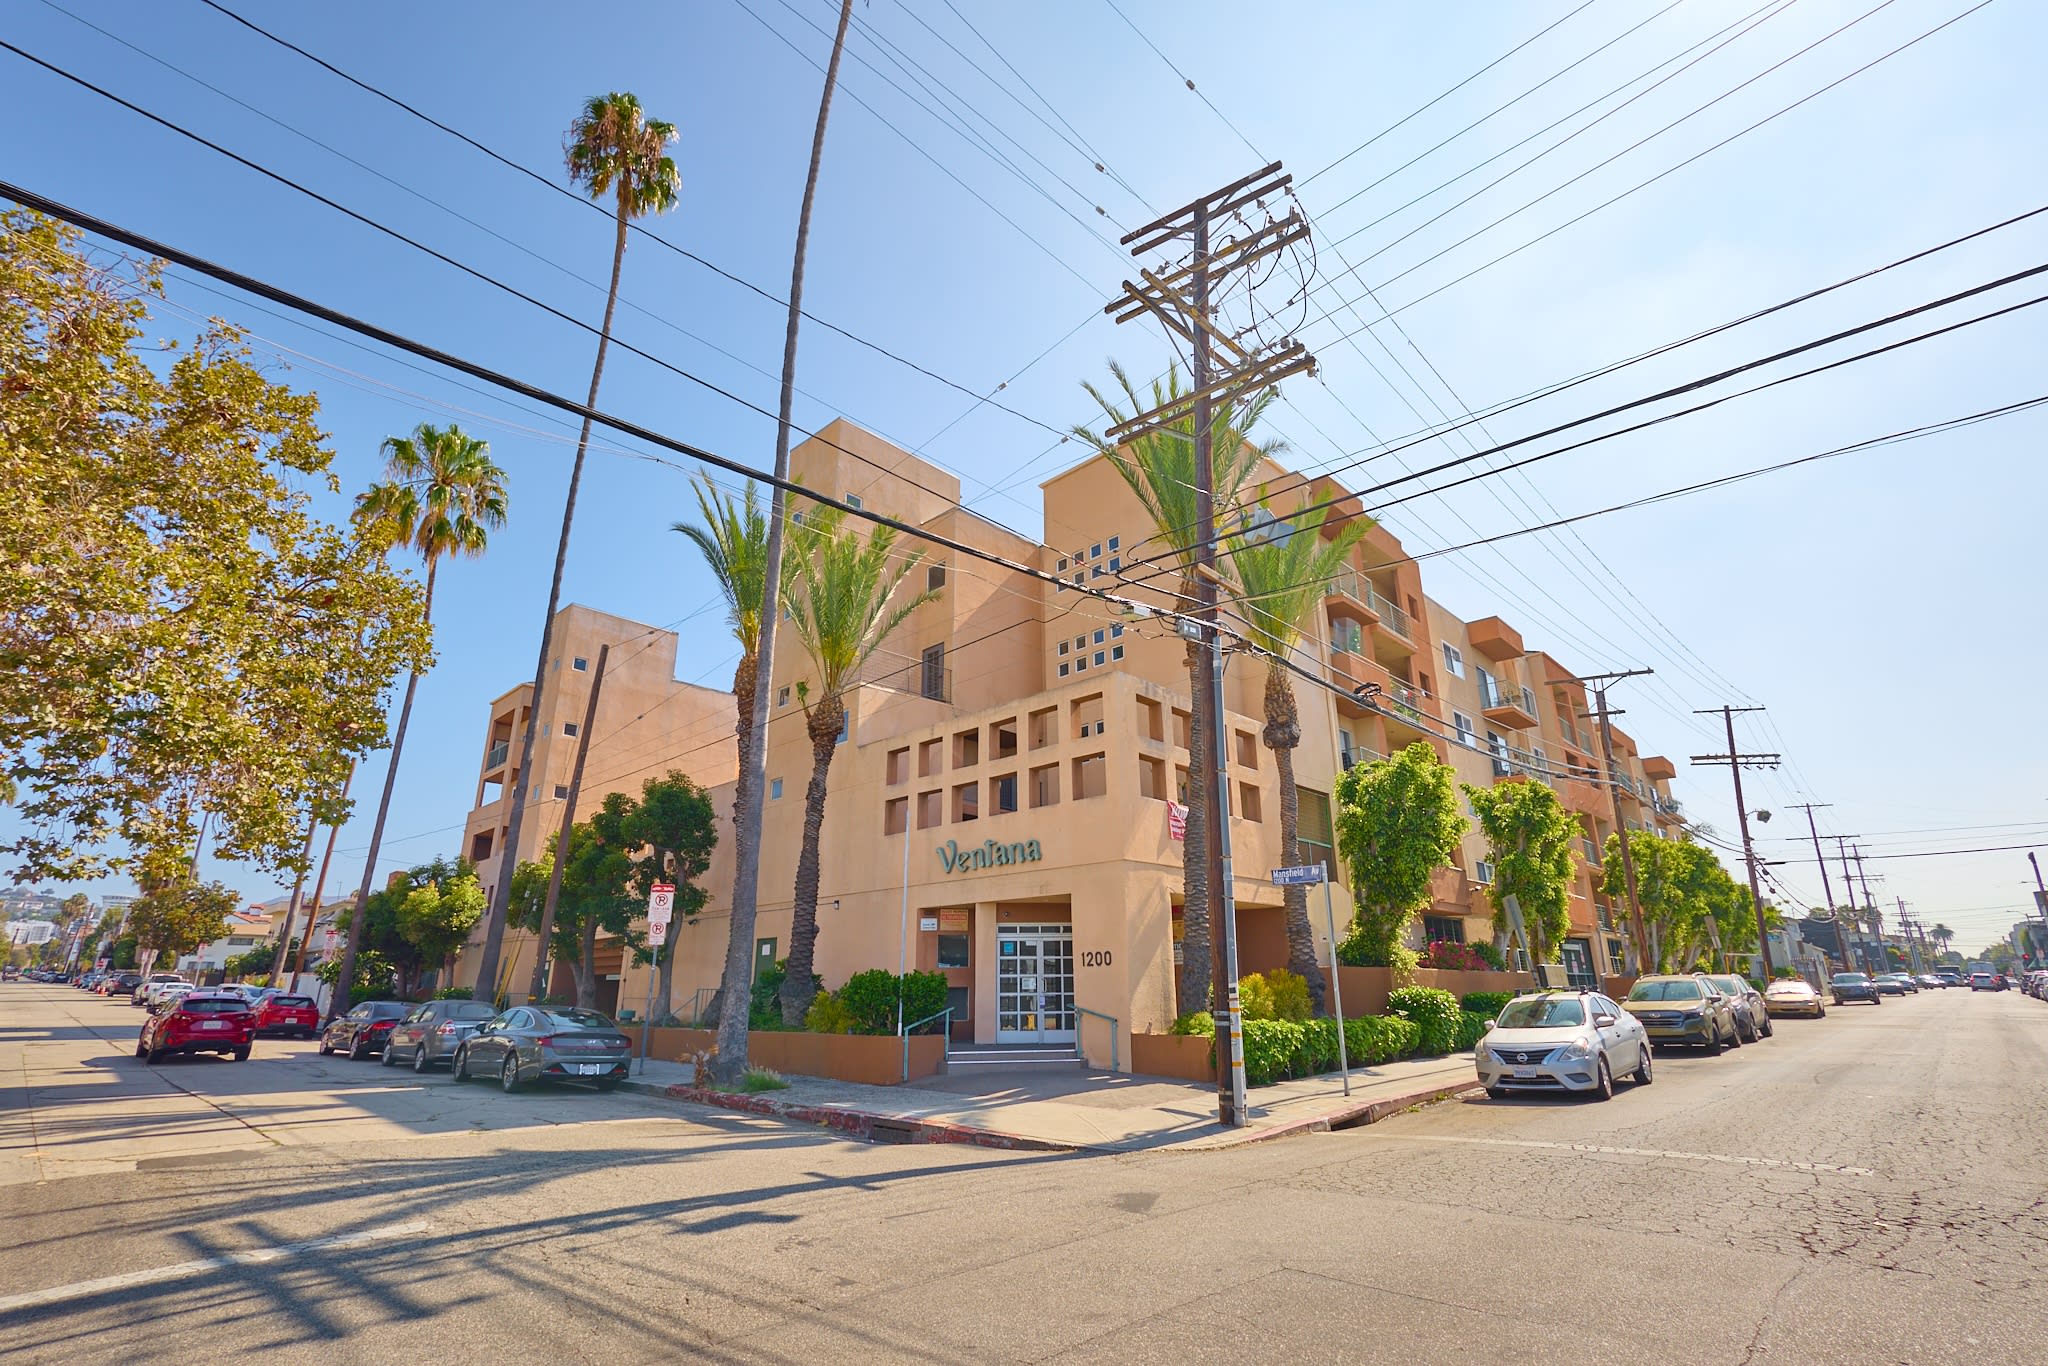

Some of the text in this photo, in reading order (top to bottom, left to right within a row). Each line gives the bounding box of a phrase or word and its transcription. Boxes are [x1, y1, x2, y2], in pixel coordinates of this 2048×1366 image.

[936, 839, 1042, 874] Ventana
[1273, 868, 1304, 878] Mansfield
[1081, 950, 1112, 967] 1200
